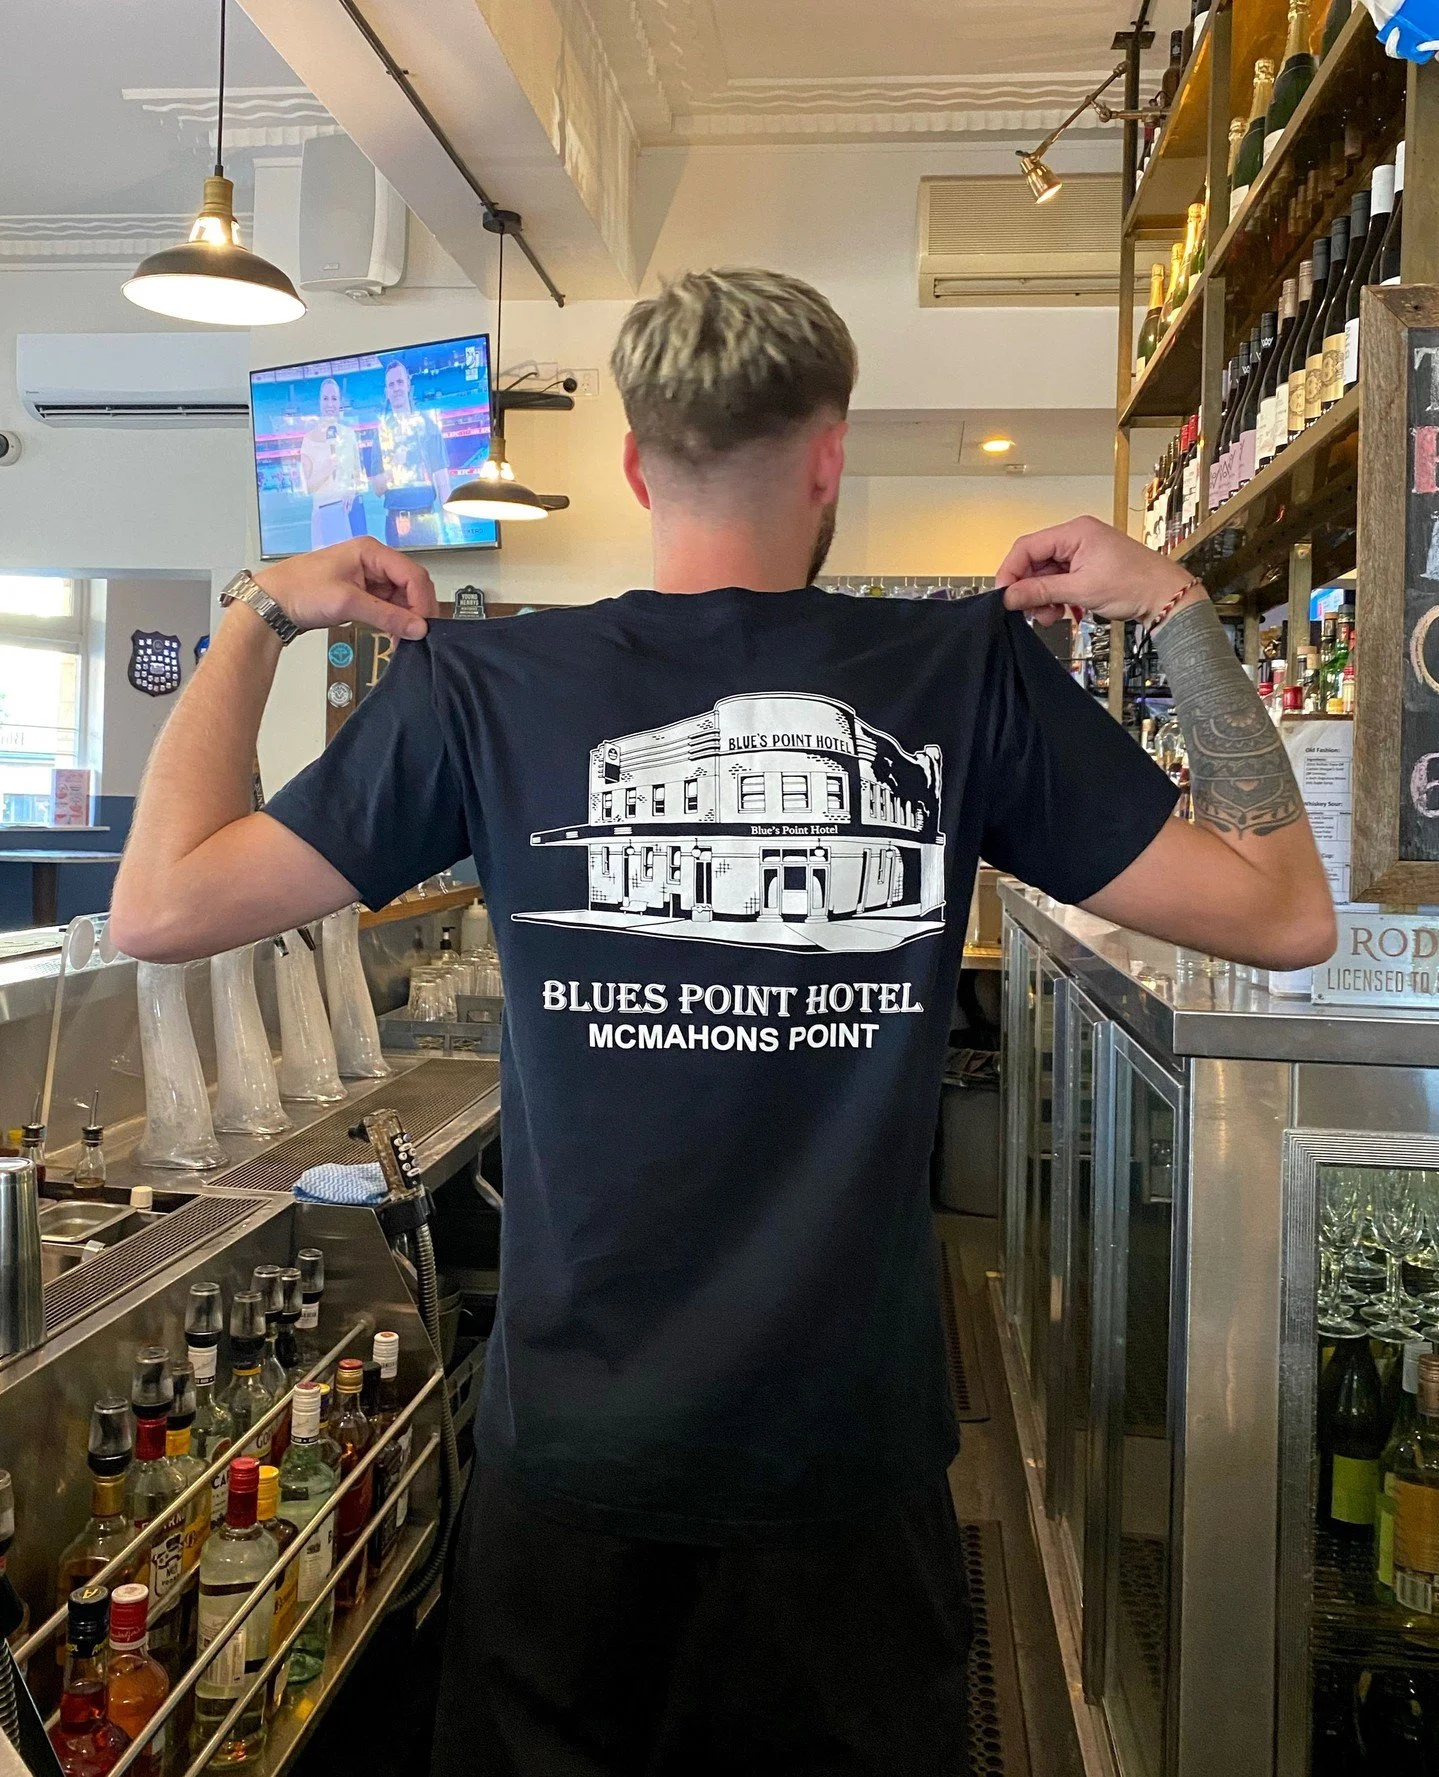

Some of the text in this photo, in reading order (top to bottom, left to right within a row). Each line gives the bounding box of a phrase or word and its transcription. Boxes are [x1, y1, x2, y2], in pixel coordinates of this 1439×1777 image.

[729, 733, 851, 754] BLUE'S POINT HOTEL
[750, 824, 839, 835] Blue's Point Hotel
[1327, 968, 1404, 993] LICENSED
[1410, 971, 1430, 993] TO
[543, 980, 924, 1017] BLUES POINT HOTEL
[589, 1023, 879, 1052] MCMAHONS POINT
